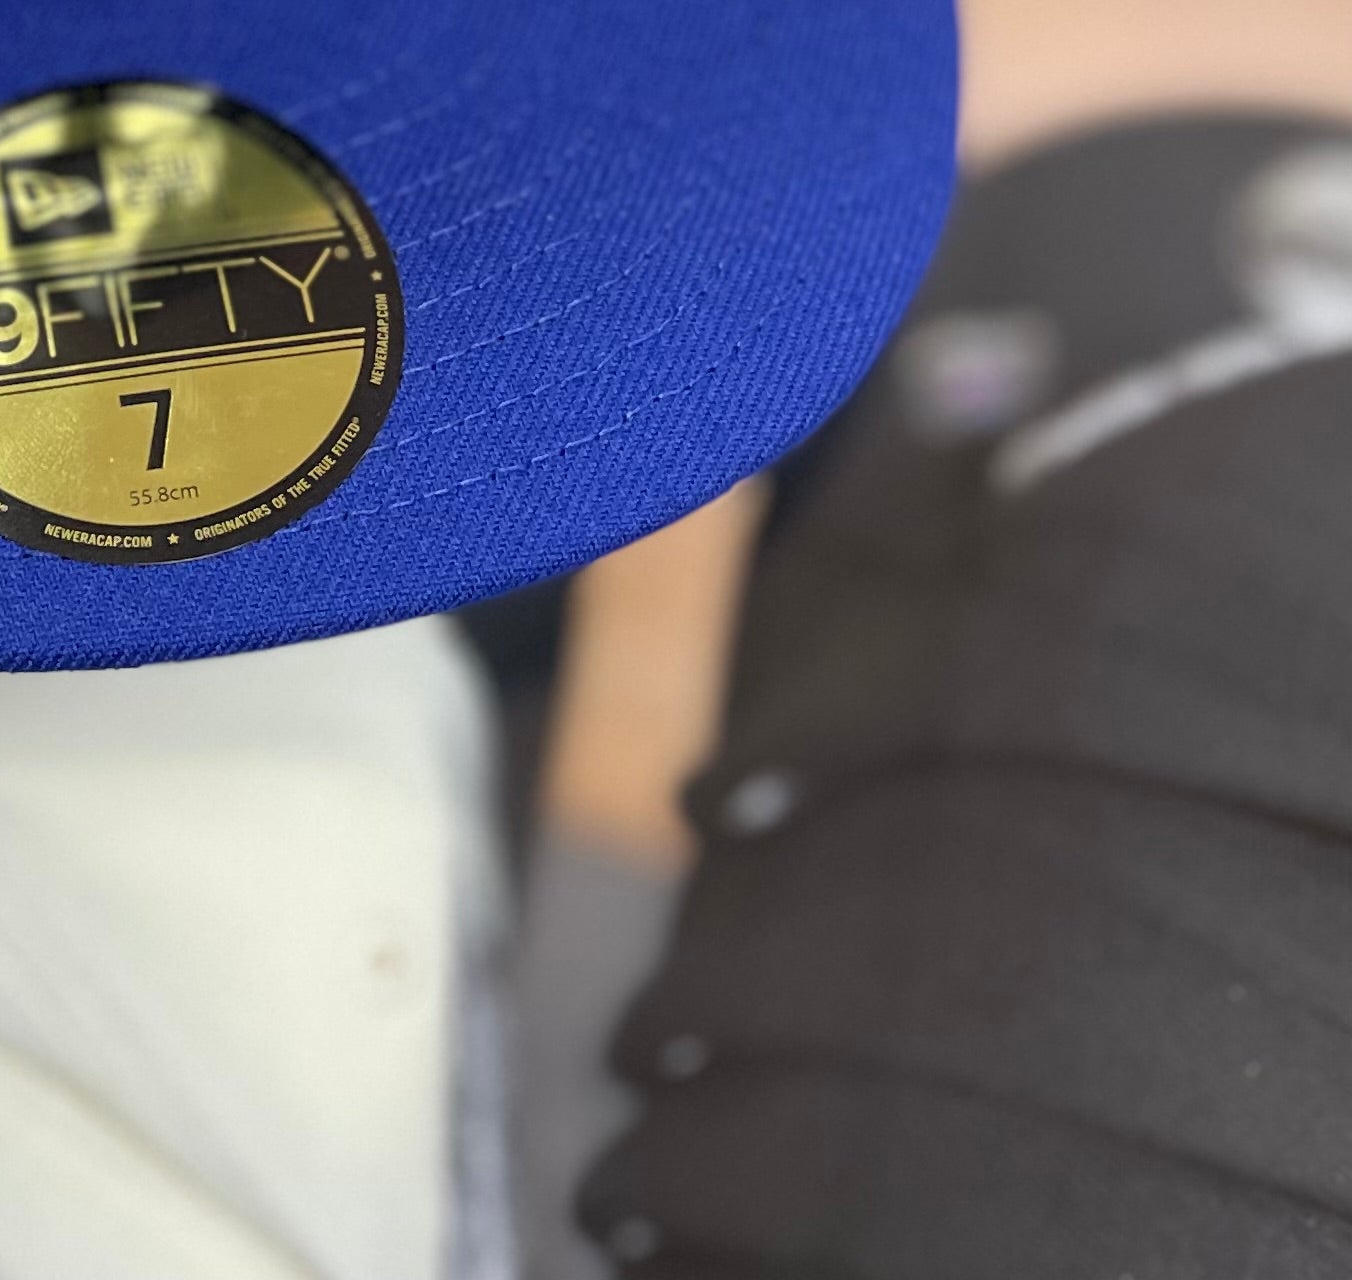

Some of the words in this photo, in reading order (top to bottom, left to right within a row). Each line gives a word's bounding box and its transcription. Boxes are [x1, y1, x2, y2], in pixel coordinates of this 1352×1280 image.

[369, 293, 389, 386] NEWERACAP.COM
[119, 388, 172, 471] 7
[44, 523, 152, 548] NEWERACAP.COM
[129, 484, 200, 507] 55.8cm
[194, 503, 272, 541] ORIGINATORS
[271, 493, 288, 510] OF
[286, 477, 312, 499] THE
[307, 454, 337, 481] TRUE
